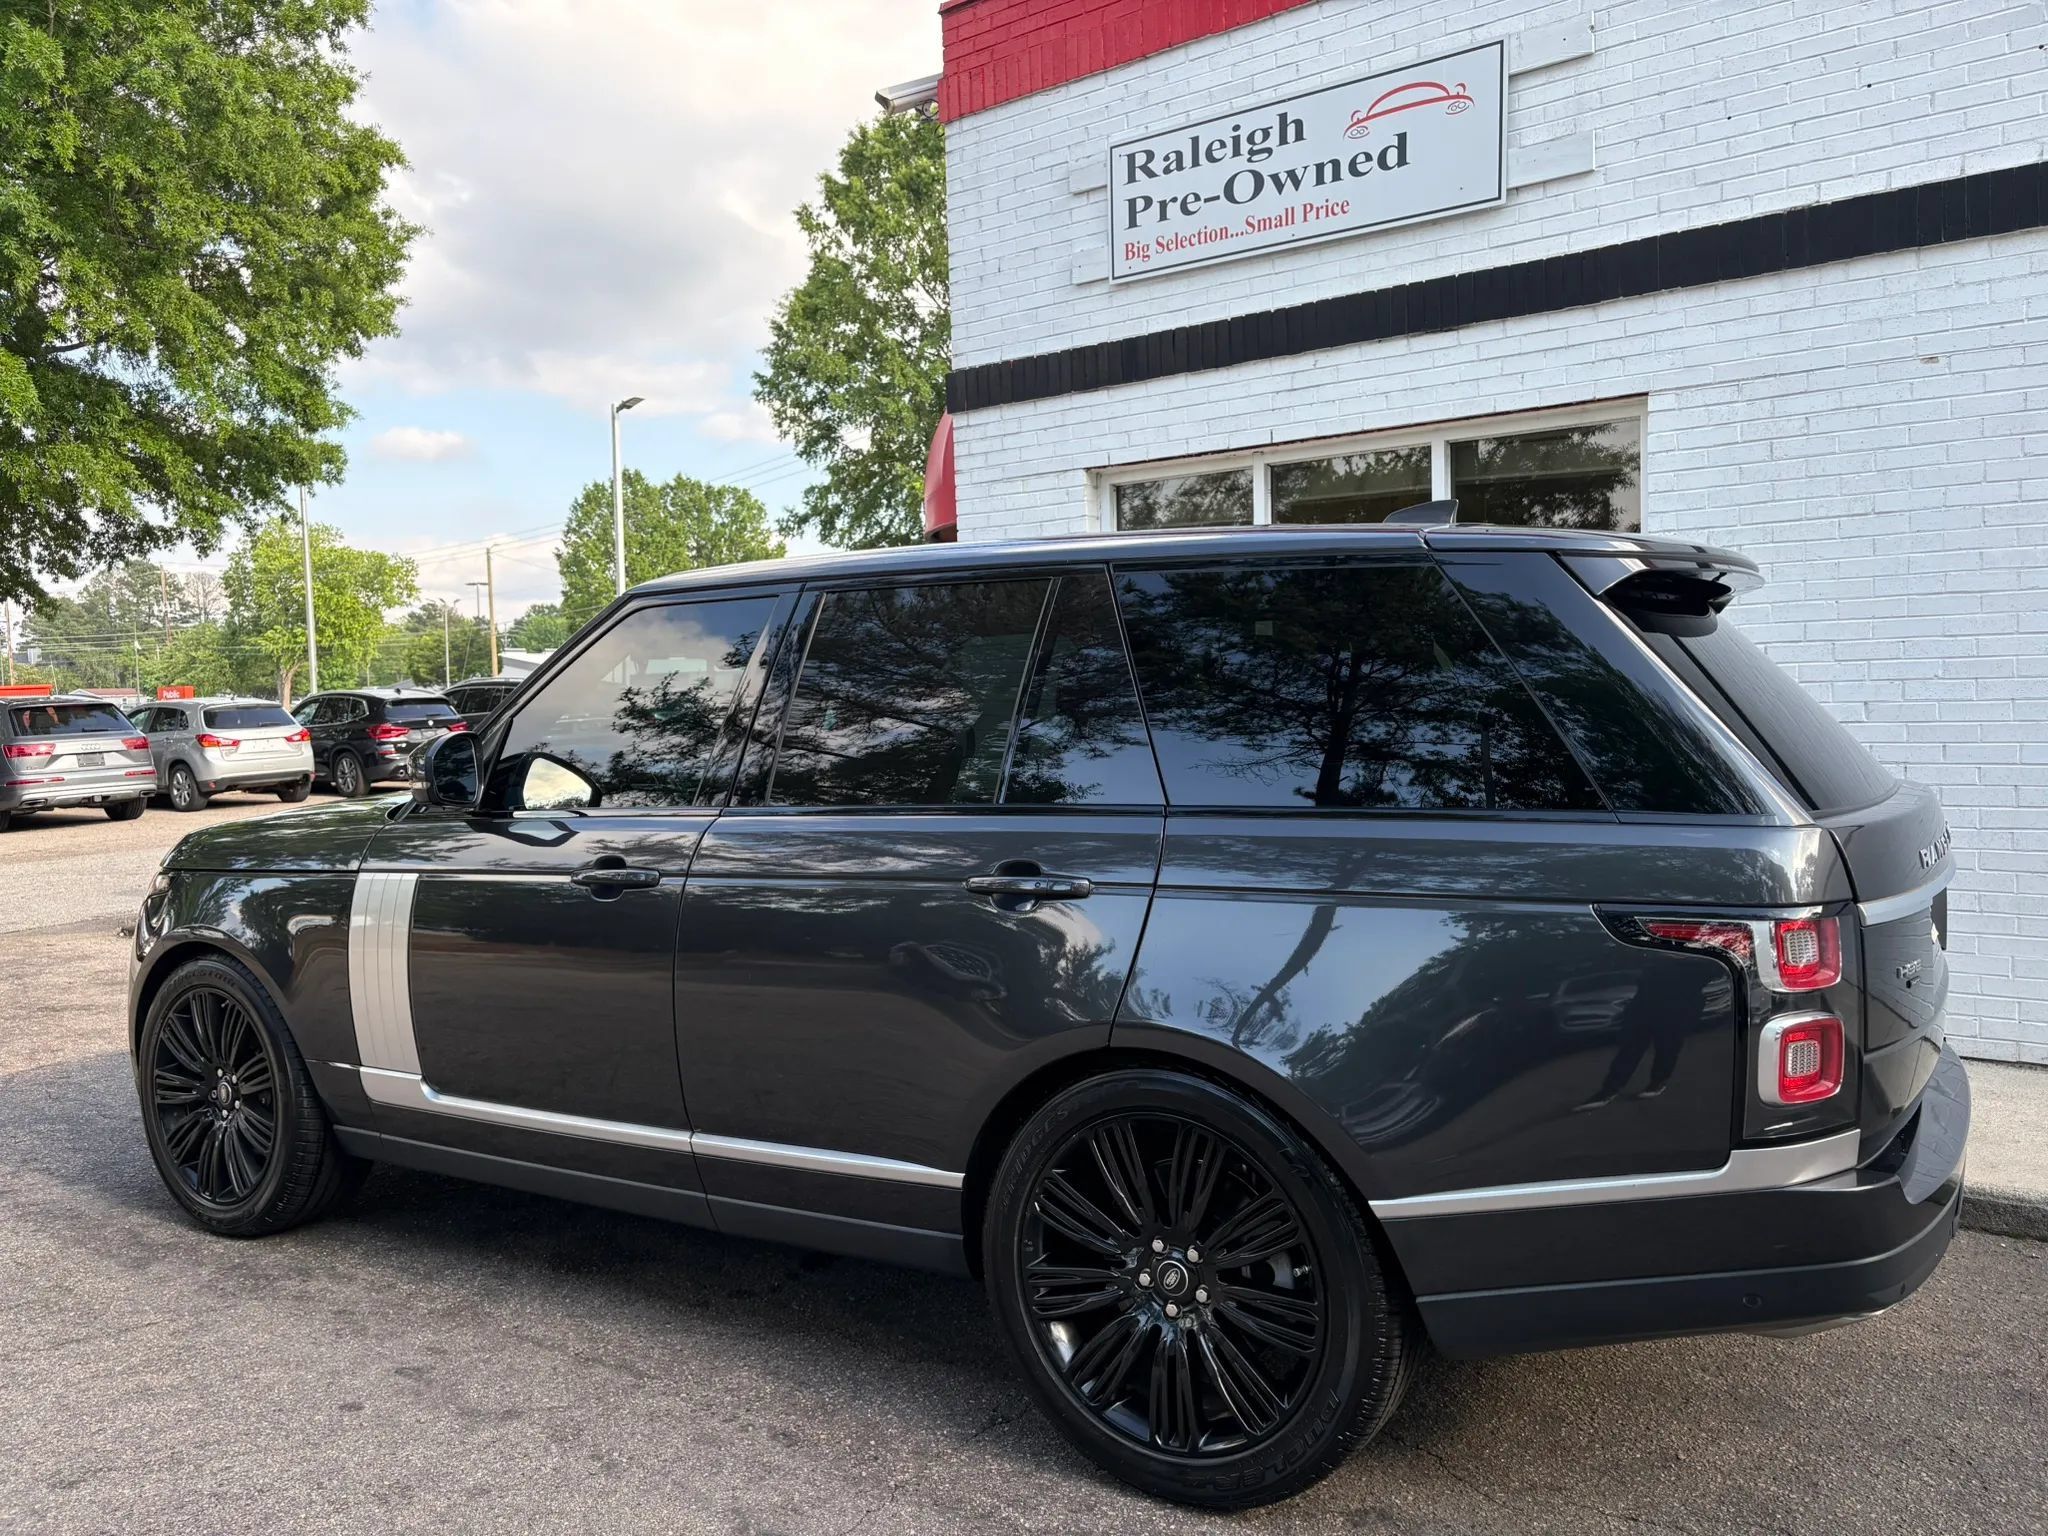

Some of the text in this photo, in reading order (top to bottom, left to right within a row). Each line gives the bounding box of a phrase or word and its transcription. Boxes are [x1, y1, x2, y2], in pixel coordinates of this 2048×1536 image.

[1122, 111, 1307, 186] Raleigh
[1124, 131, 1411, 230] Pre-Owned
[1124, 240, 1151, 262] Big
[1302, 198, 1351, 223] Price
